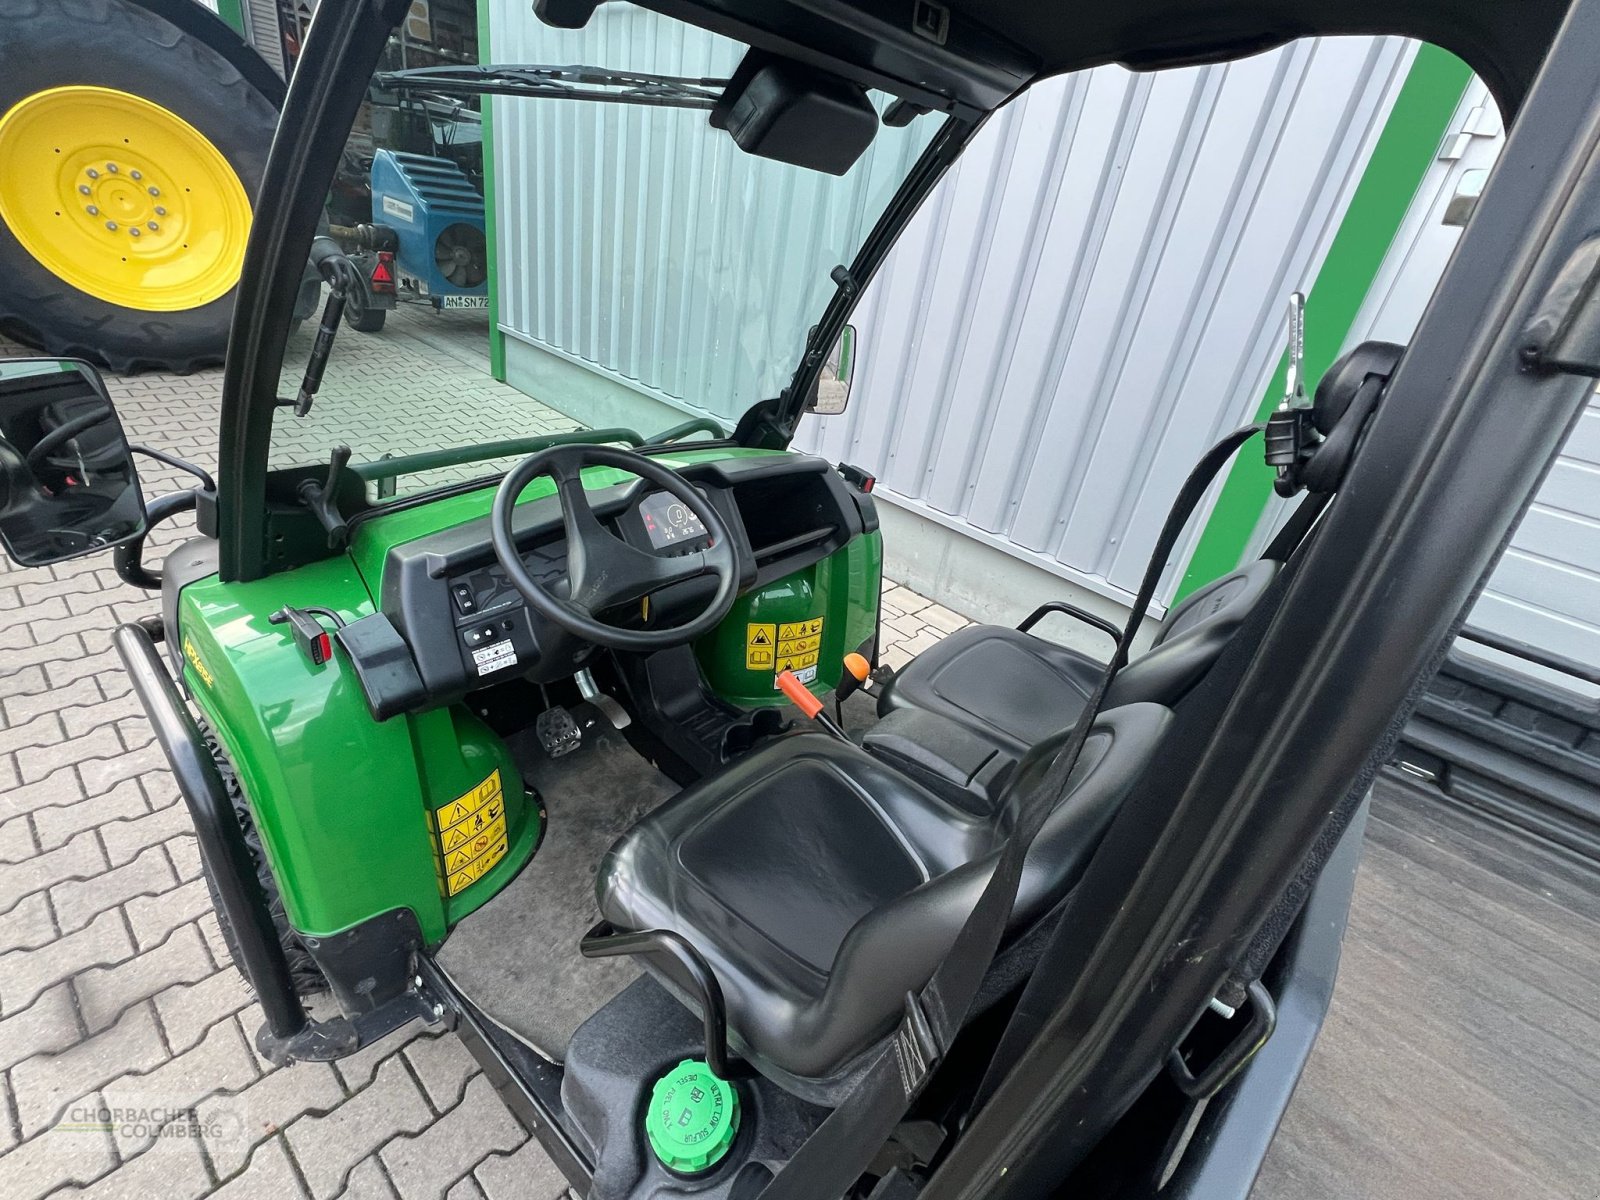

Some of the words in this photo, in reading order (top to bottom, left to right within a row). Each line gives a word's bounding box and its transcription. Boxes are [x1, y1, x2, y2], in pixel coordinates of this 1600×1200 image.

[446, 297, 458, 307] AN
[464, 297, 477, 307] SN
[676, 1073, 698, 1086] DIESEL
[663, 1087, 676, 1105] FUEL
[710, 1084, 722, 1107] ULTRA
[662, 1109, 673, 1130] ONLY
[710, 1112, 722, 1128] LOW
[684, 1127, 709, 1143] SULFUR
